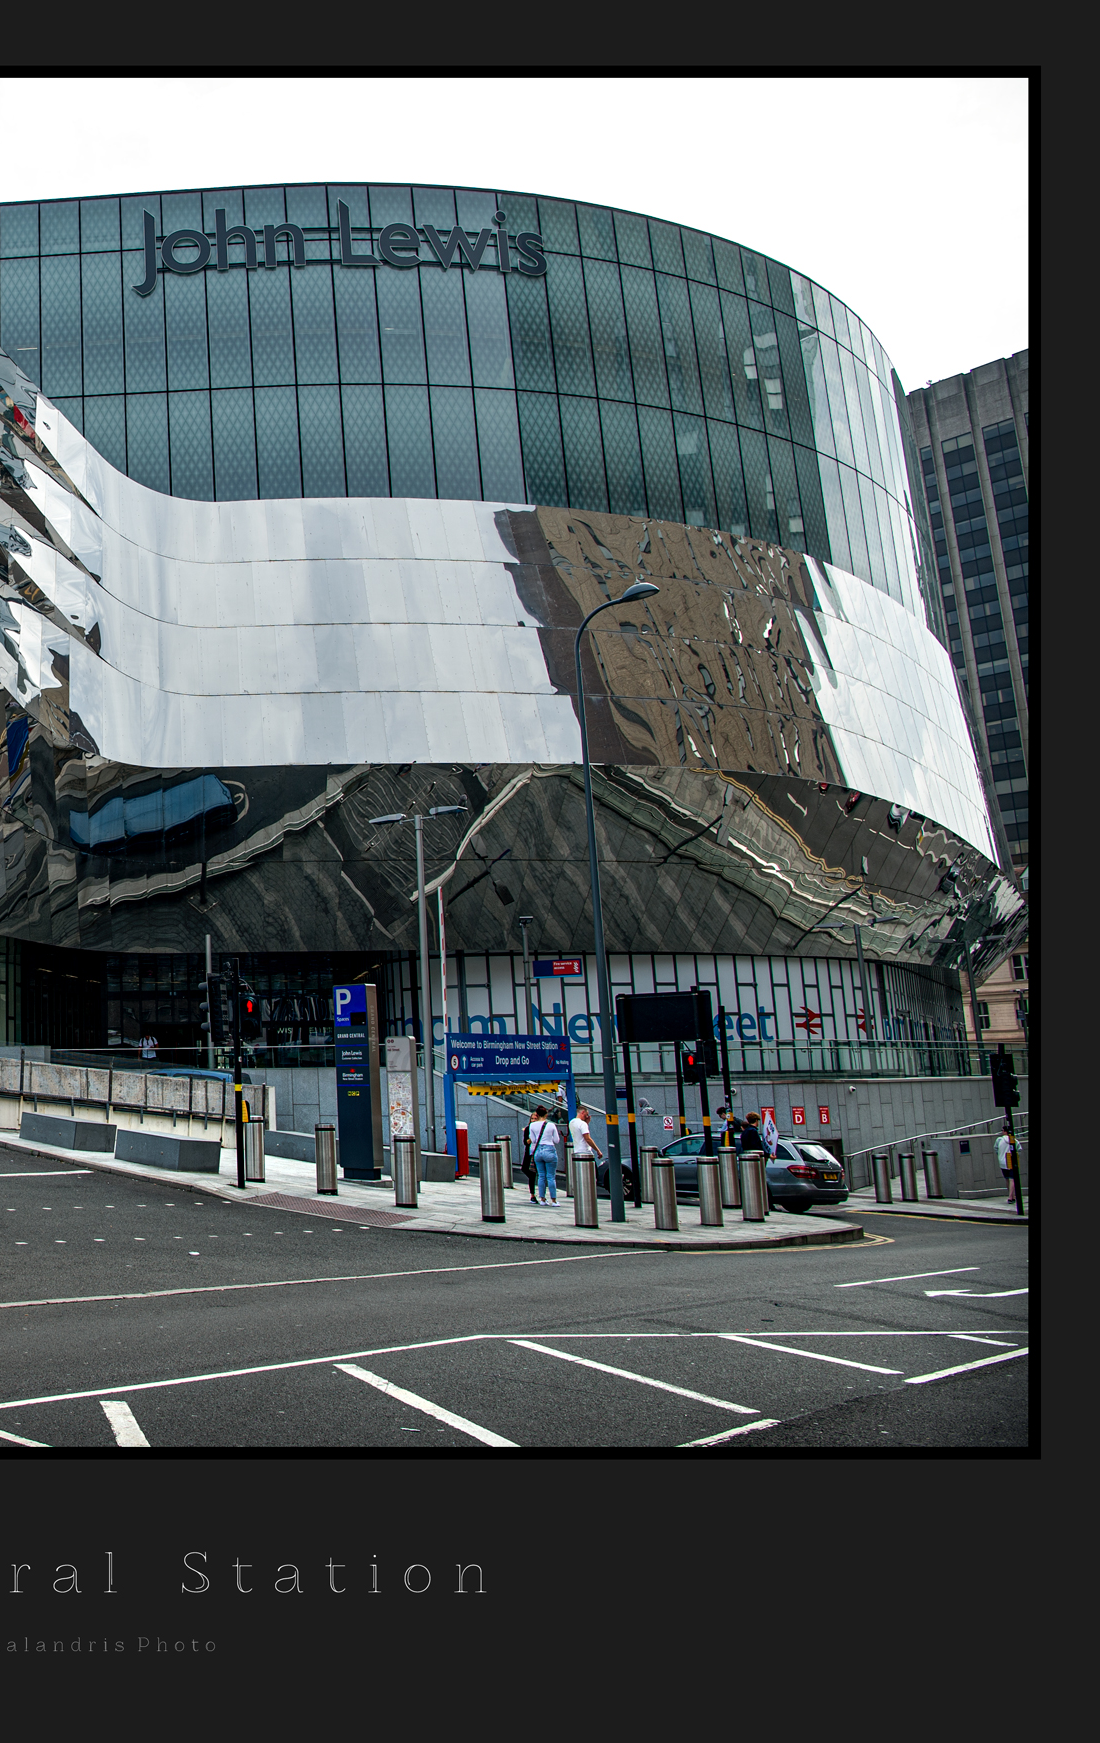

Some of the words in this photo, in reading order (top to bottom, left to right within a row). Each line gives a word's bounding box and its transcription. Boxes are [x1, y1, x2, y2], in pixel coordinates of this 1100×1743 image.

[132, 207, 307, 297] John
[339, 198, 548, 277] Lewis
[336, 989, 351, 1015] P
[451, 1040, 475, 1049] Welcome
[477, 1041, 482, 1049] to
[483, 1041, 514, 1051] Birmingham
[526, 1042, 541, 1050] Street
[542, 1042, 558, 1050] Station
[496, 1055, 509, 1067] Drop
[510, 1056, 520, 1065] and
[521, 1056, 529, 1065] Go
[795, 1115, 803, 1123] D
[822, 1114, 827, 1122] B
